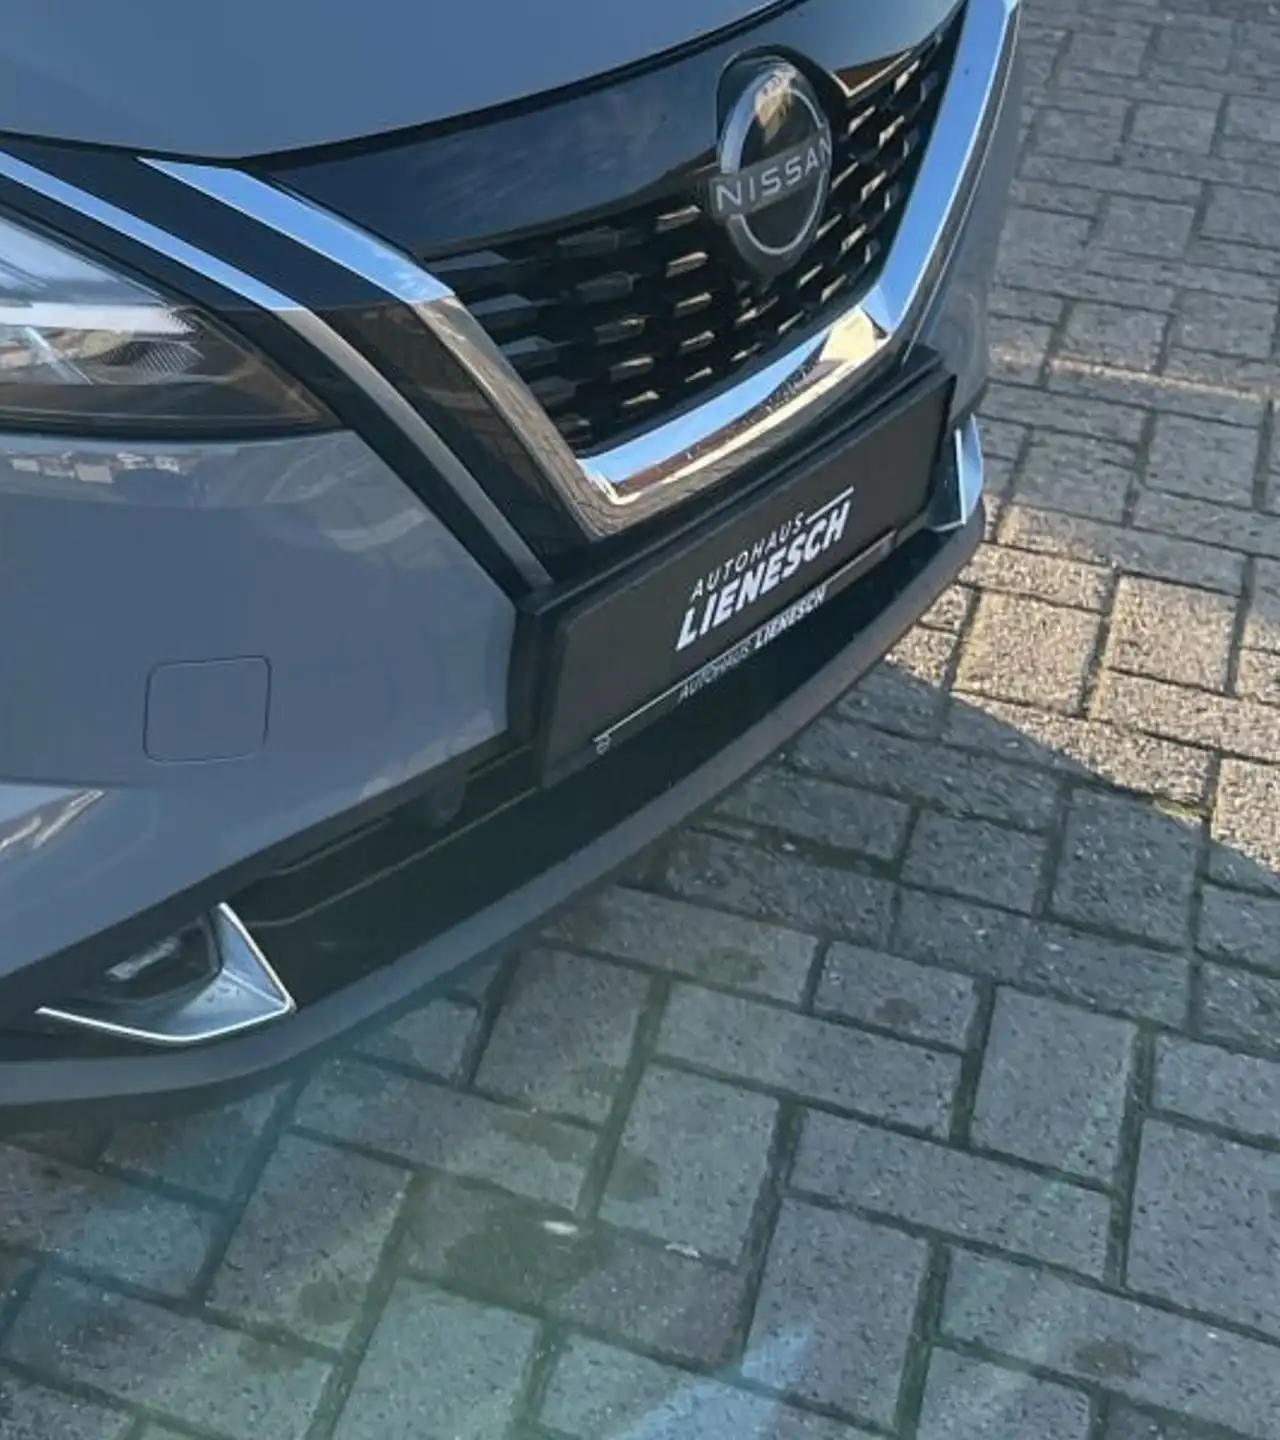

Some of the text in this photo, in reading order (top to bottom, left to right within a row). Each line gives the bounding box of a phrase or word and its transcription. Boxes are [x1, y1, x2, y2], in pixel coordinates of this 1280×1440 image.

[716, 137, 832, 211] NISSAN
[675, 499, 852, 652] LIENESCH
[690, 511, 805, 600] AUTOHAUS
